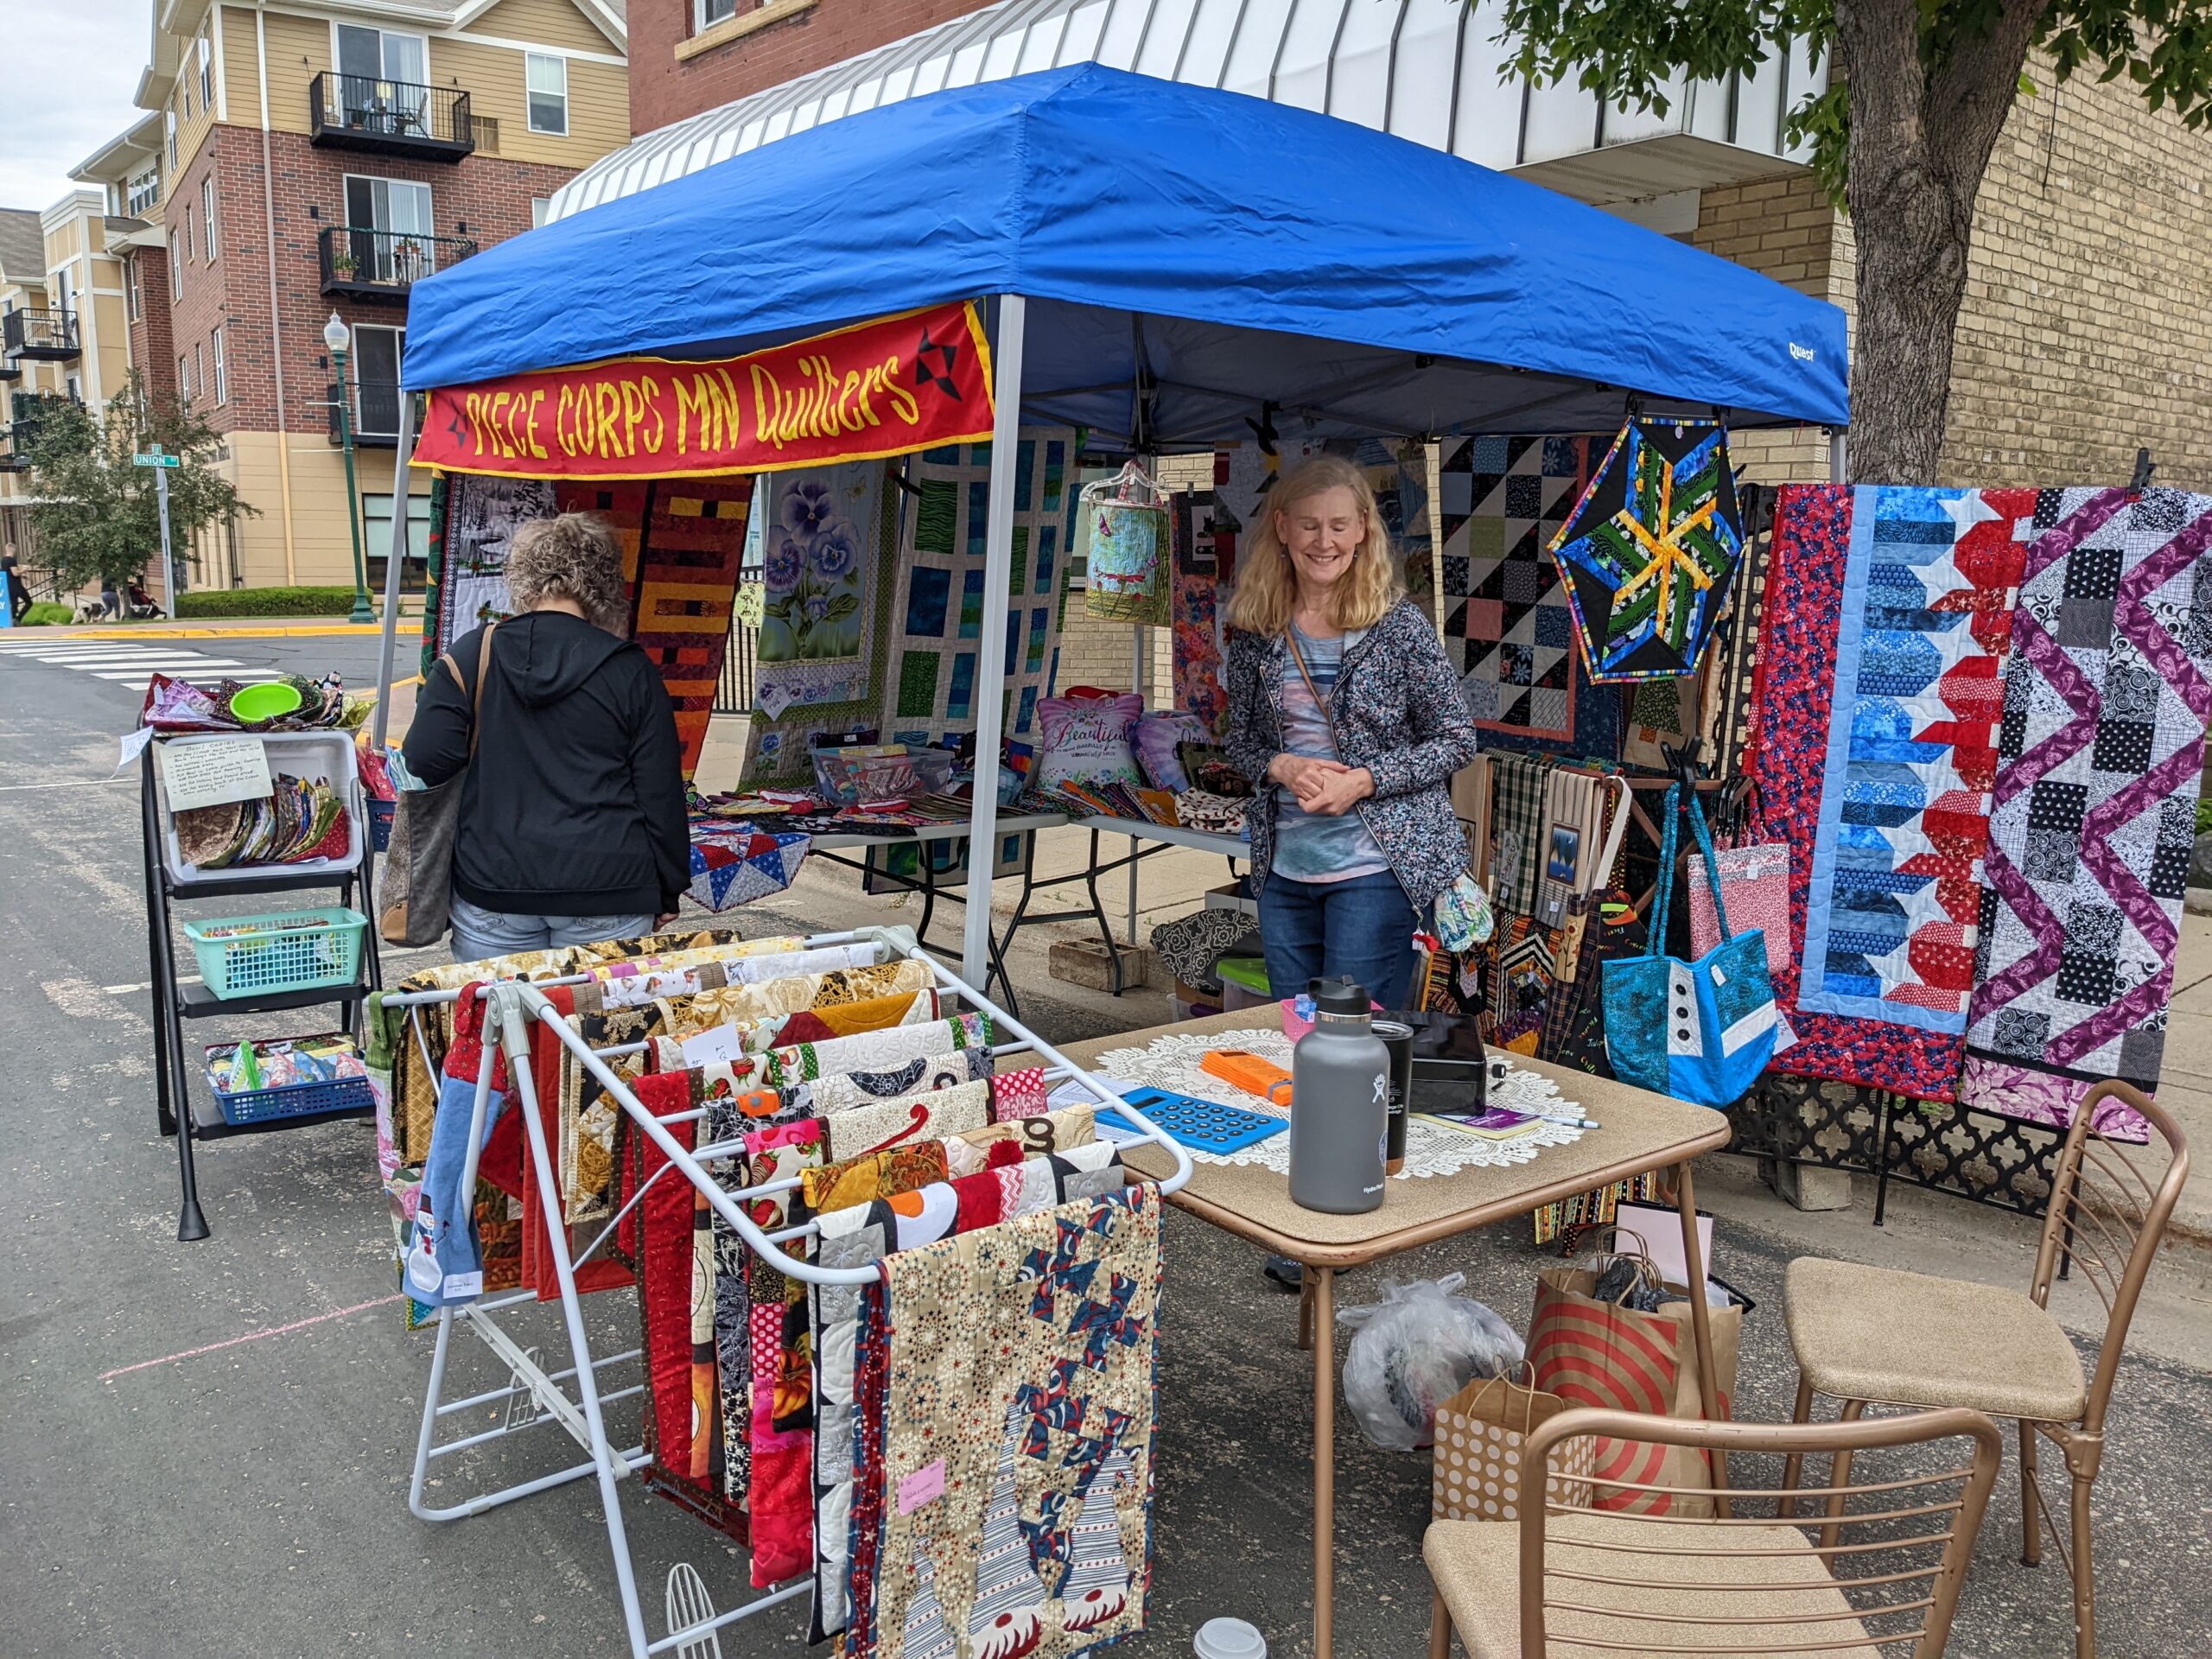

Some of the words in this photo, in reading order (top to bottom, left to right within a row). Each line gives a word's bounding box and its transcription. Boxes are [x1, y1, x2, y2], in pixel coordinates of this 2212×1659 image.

[1789, 342, 1814, 363] Quest
[467, 390, 548, 459] PIECE
[557, 375, 664, 459] CORPS
[671, 368, 739, 454] MN
[750, 355, 919, 449] Quilters
[135, 455, 165, 465] UNION
[1052, 719, 1130, 749] Beautiful
